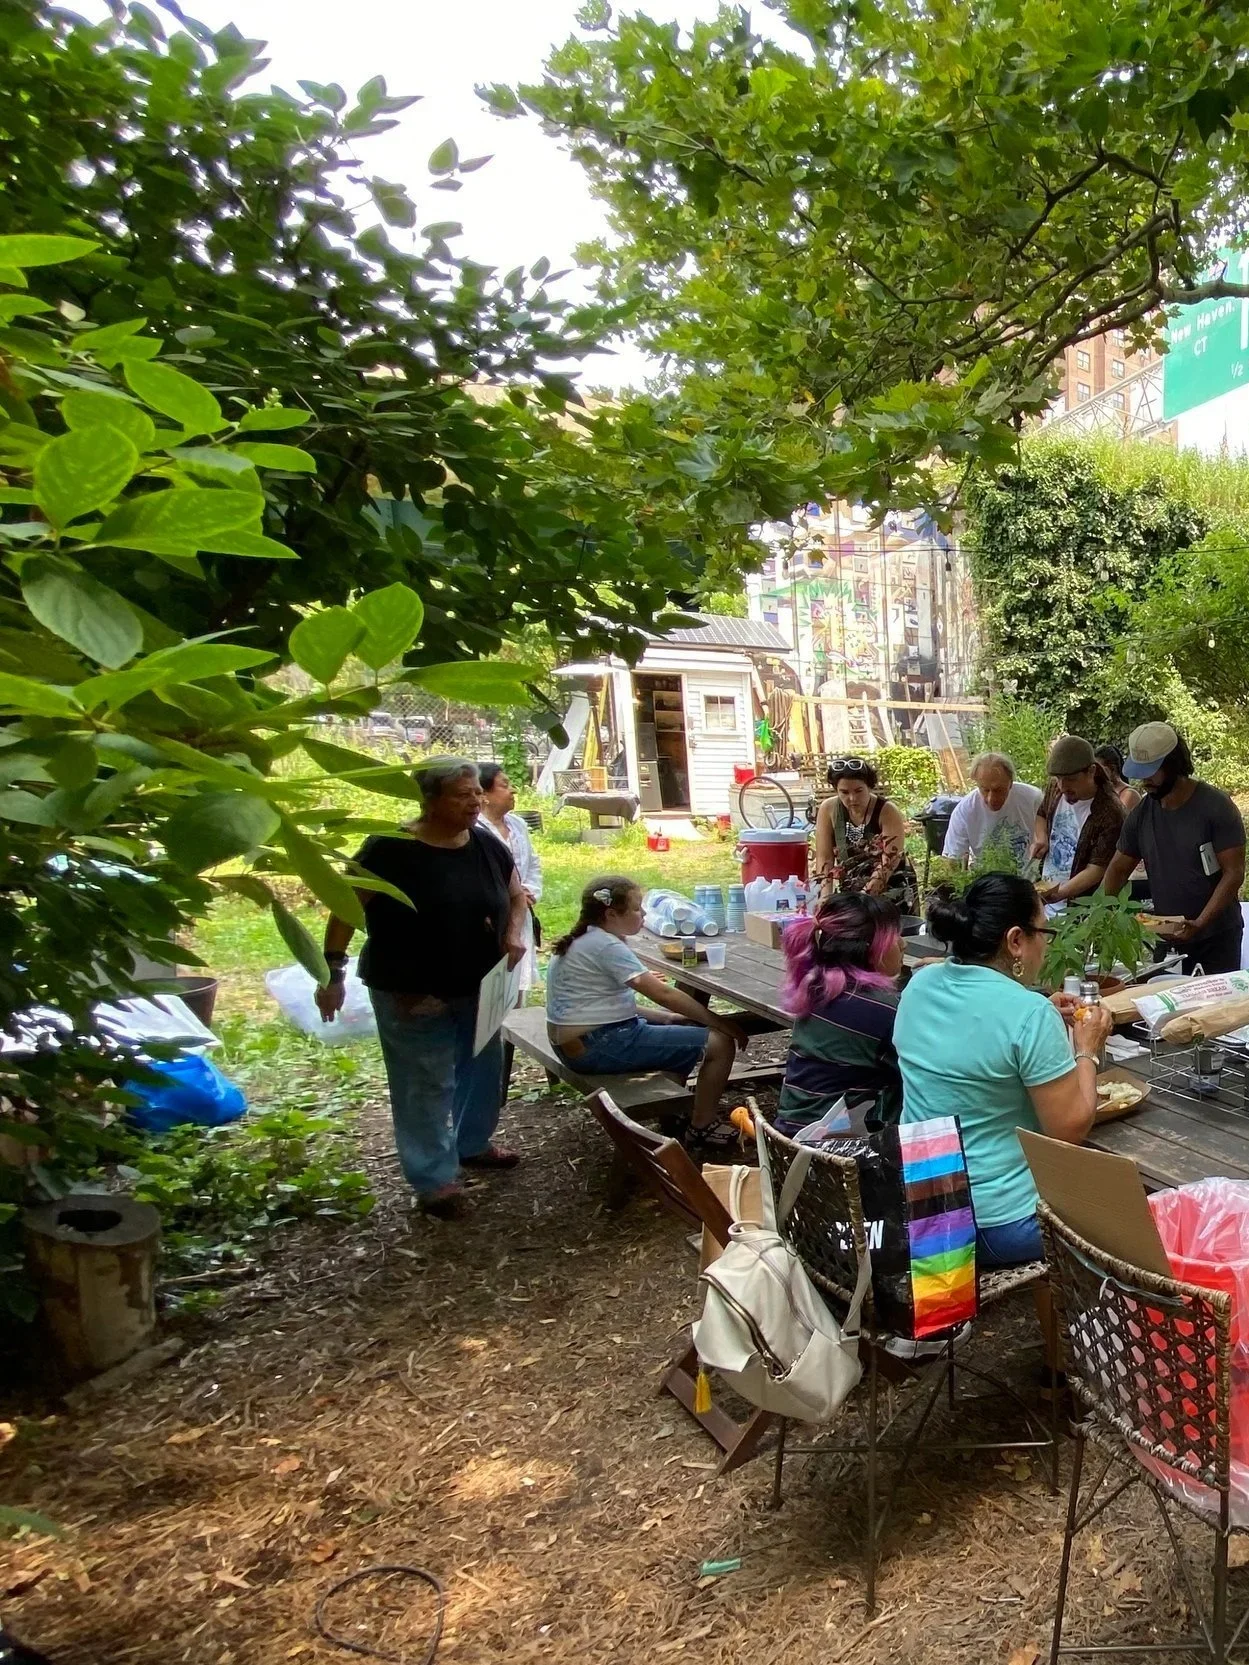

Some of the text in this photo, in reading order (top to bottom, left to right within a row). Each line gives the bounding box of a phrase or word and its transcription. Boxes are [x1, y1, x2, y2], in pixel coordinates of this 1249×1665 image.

[1170, 324, 1192, 345] New
[1193, 336, 1208, 356] CT
[1230, 361, 1244, 379] 1/2
